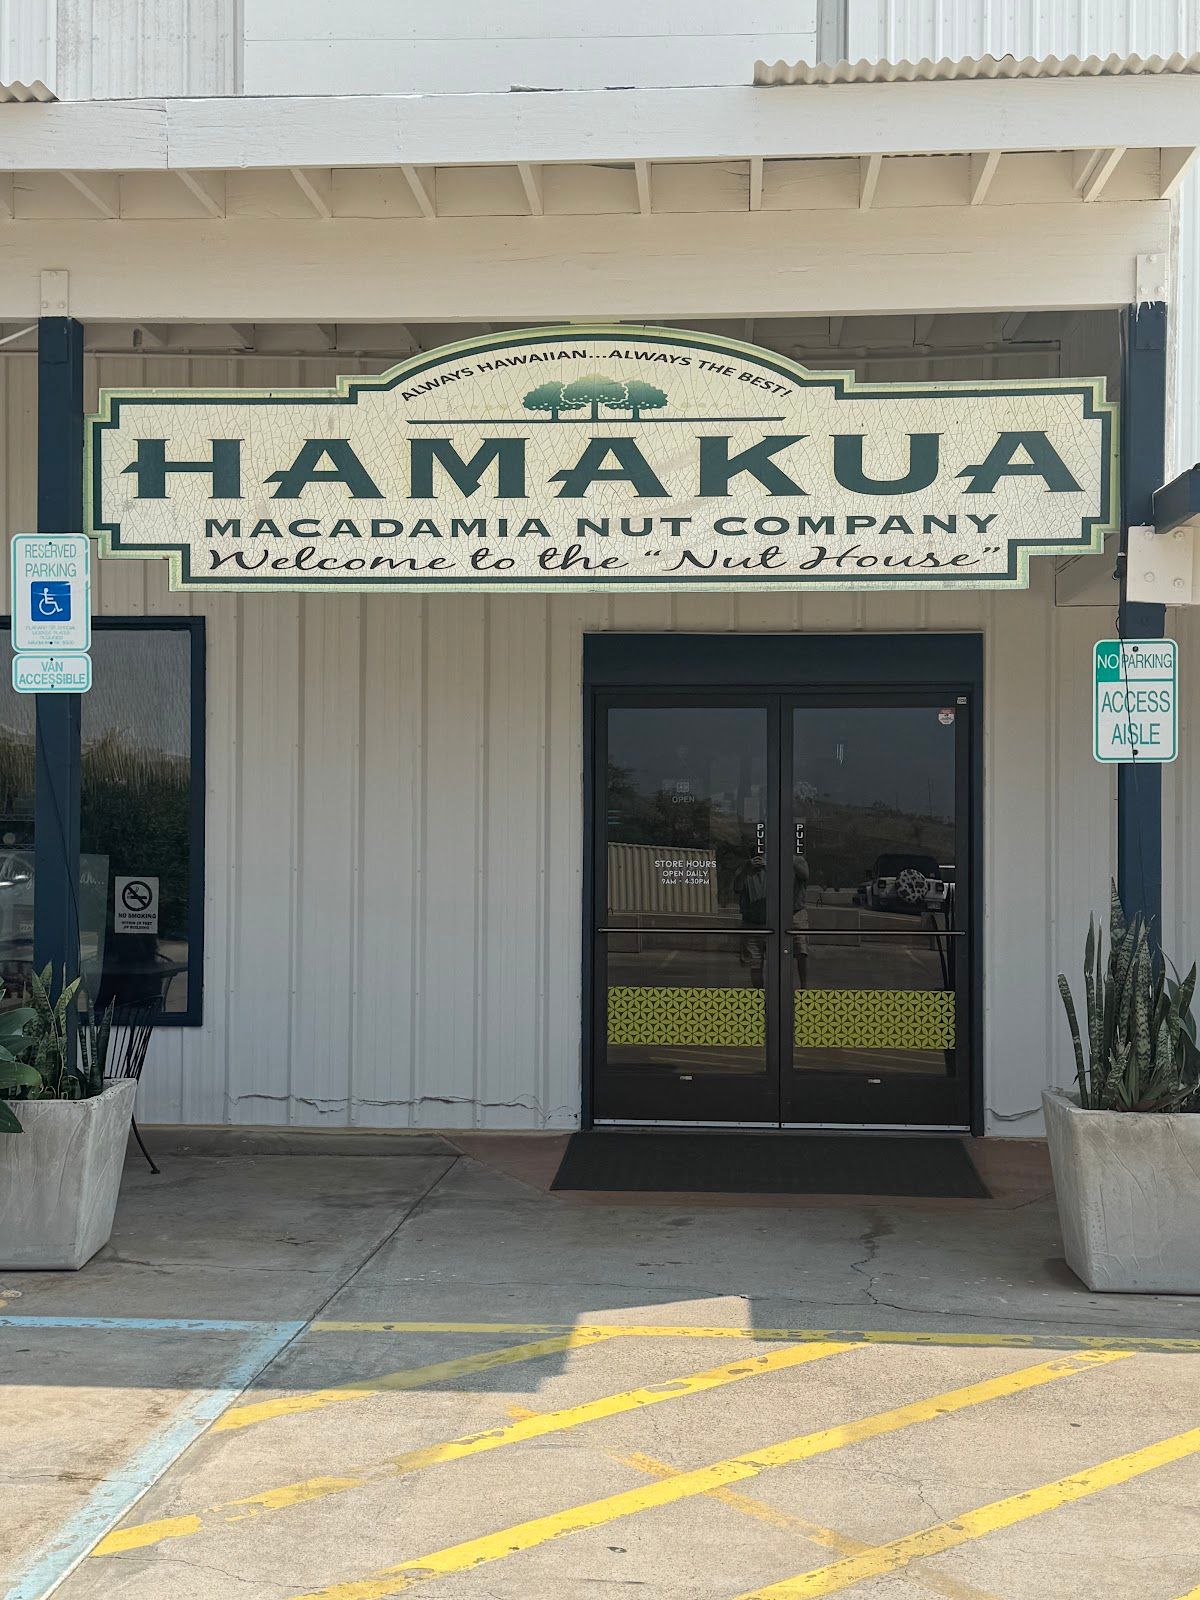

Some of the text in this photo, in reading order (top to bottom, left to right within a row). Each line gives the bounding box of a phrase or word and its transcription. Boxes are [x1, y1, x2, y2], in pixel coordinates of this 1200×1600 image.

[401, 367, 475, 402] ALWAYS
[698, 359, 737, 377] THE
[737, 371, 793, 398] BEST!
[120, 430, 1085, 499] HAMAKUA
[204, 513, 999, 538] MACADAMIA NUT COMPANY
[24, 543, 77, 559] RESERVED
[208, 546, 457, 571] Welcome
[469, 547, 516, 571] to
[537, 543, 630, 571] the
[25, 562, 77, 578] PARKING
[41, 661, 64, 673] VAN
[1097, 653, 1173, 669] NO PARKING
[18, 673, 86, 685] ACCESSIBLE
[1101, 690, 1171, 713] ACCESS
[1111, 722, 1161, 745] AISLE
[671, 795, 695, 804] OPEN
[756, 823, 765, 854] PULL
[795, 823, 804, 854] PULL
[654, 860, 717, 868] STORE HOURS
